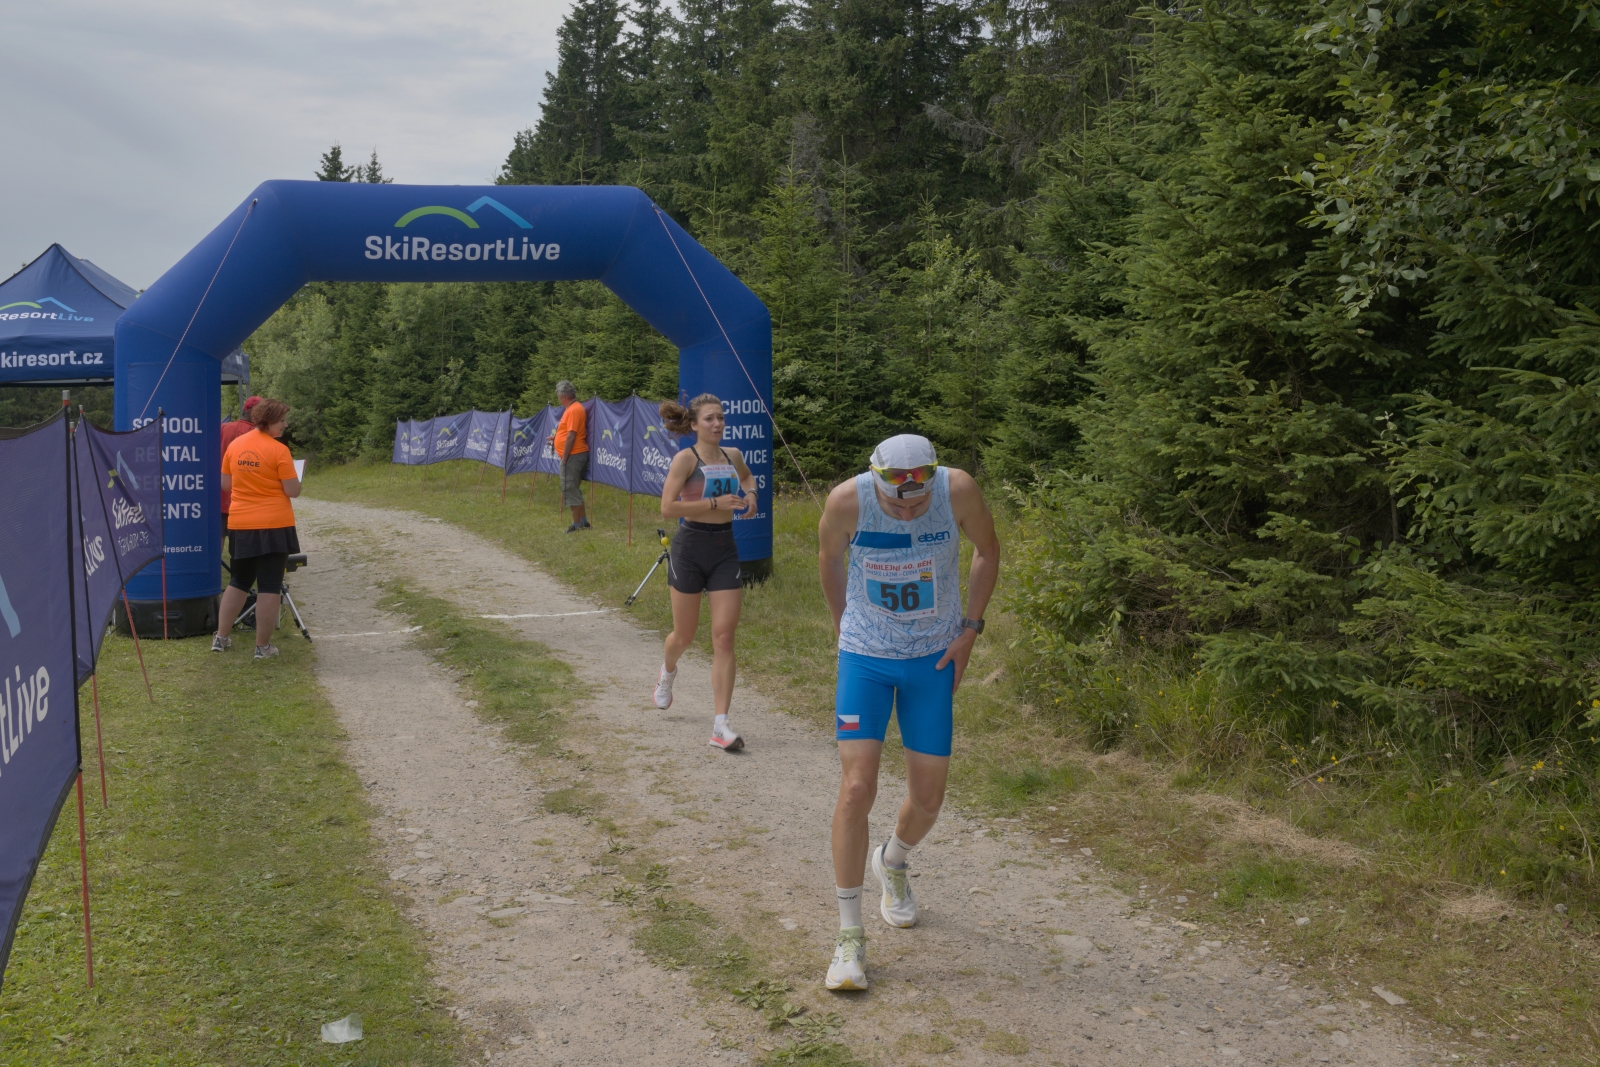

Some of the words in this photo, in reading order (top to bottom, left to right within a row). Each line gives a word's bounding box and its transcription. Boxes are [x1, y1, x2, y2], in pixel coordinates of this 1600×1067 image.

[364, 235, 561, 261] SkiResortLive
[1, 350, 104, 369] kiresort.cz
[721, 399, 766, 415] CHOOL
[132, 417, 203, 434] SCHOOL
[722, 424, 765, 440] ENTAL
[741, 449, 767, 465] VICE
[712, 479, 732, 498] 34
[918, 530, 950, 543] eleven
[163, 545, 202, 553] iresort.cz
[880, 582, 920, 612] 56
